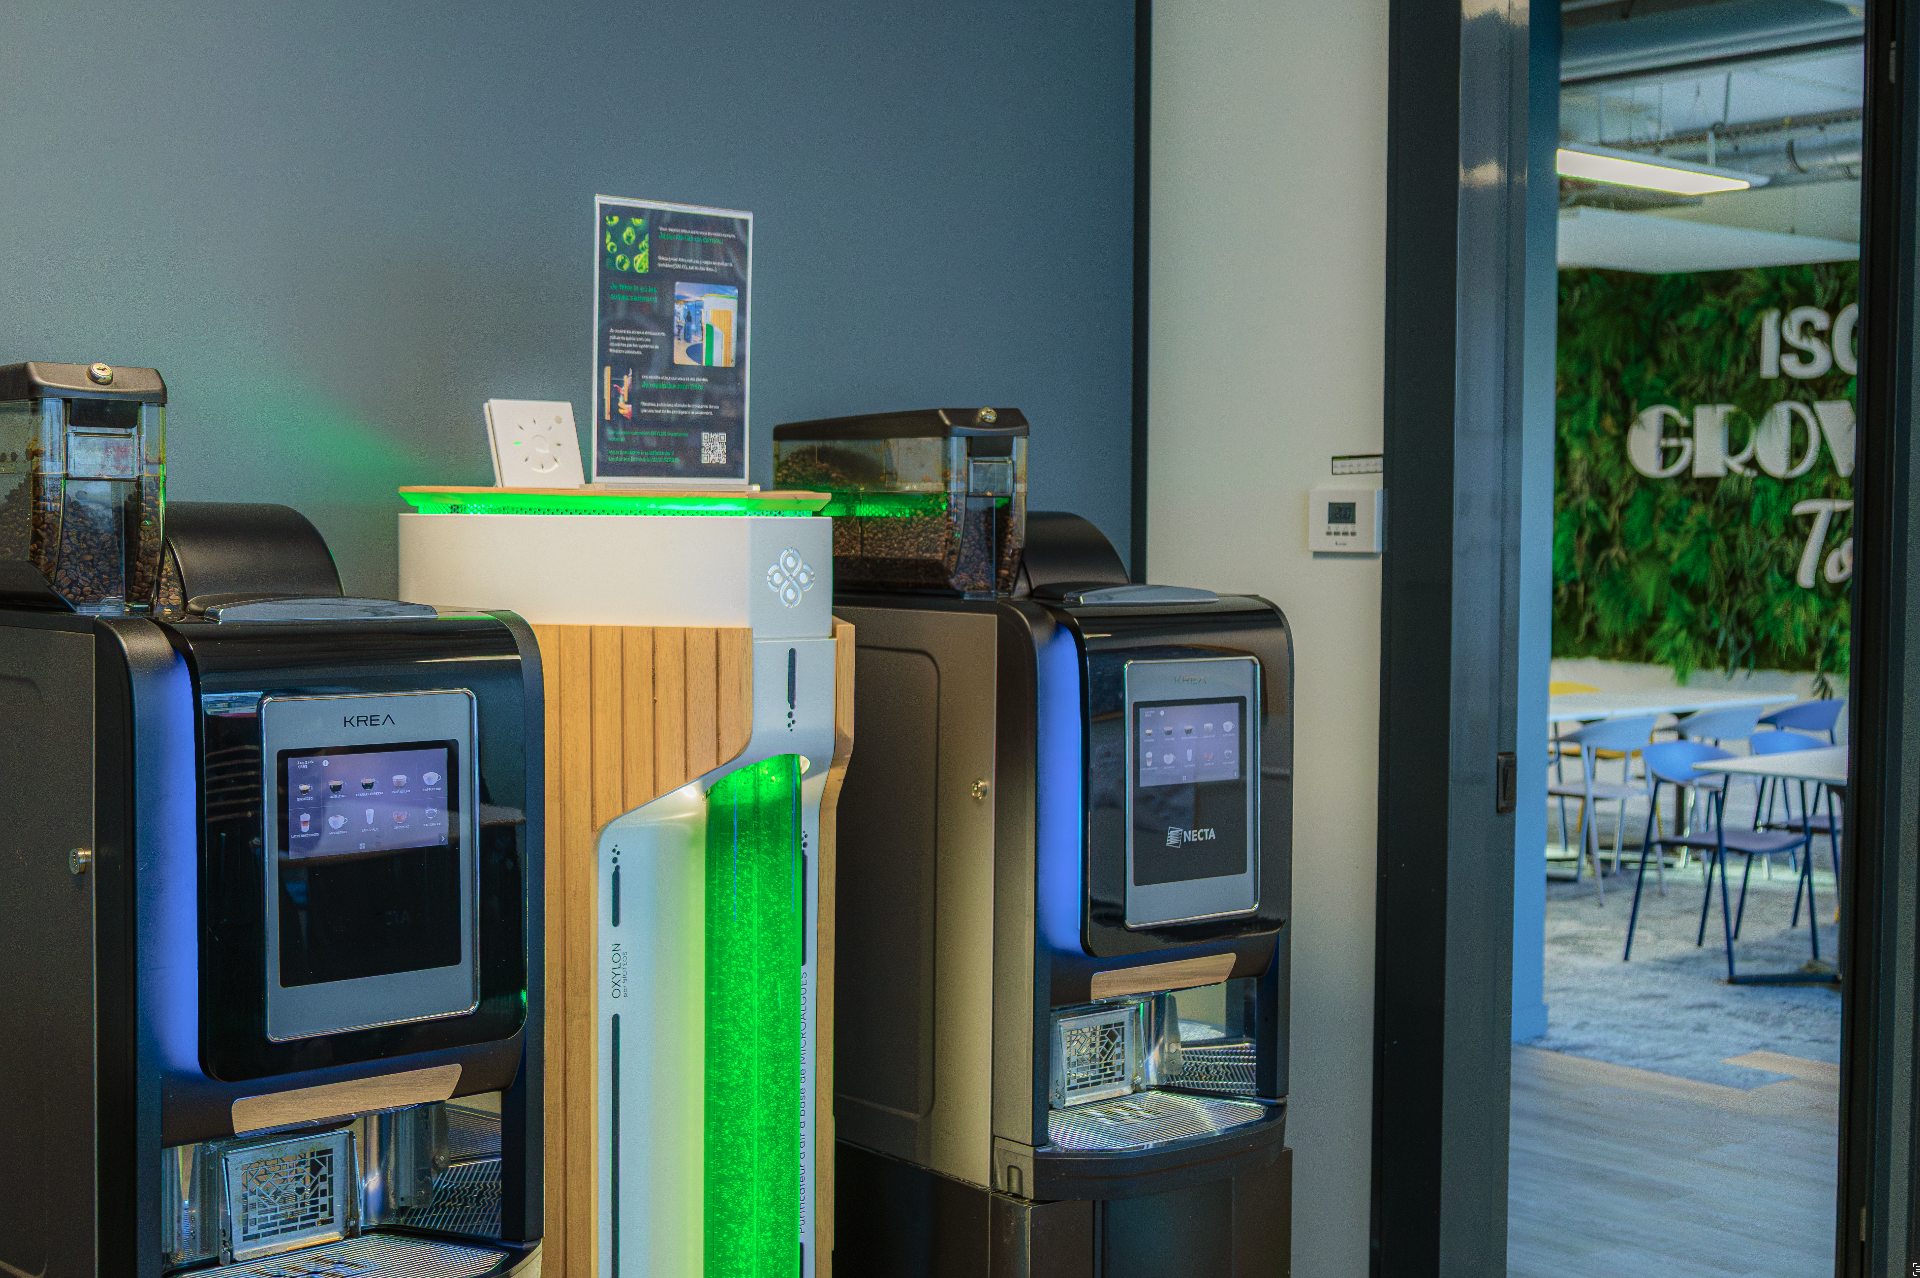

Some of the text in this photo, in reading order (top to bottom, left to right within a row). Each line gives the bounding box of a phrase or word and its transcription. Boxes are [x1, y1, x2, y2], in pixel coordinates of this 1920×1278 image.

[1173, 675, 1207, 686] KREA
[343, 713, 396, 728] KREA
[1183, 827, 1216, 843] NECTA
[611, 943, 622, 999] OXYLON
[800, 971, 808, 1065] MICROALGUES
